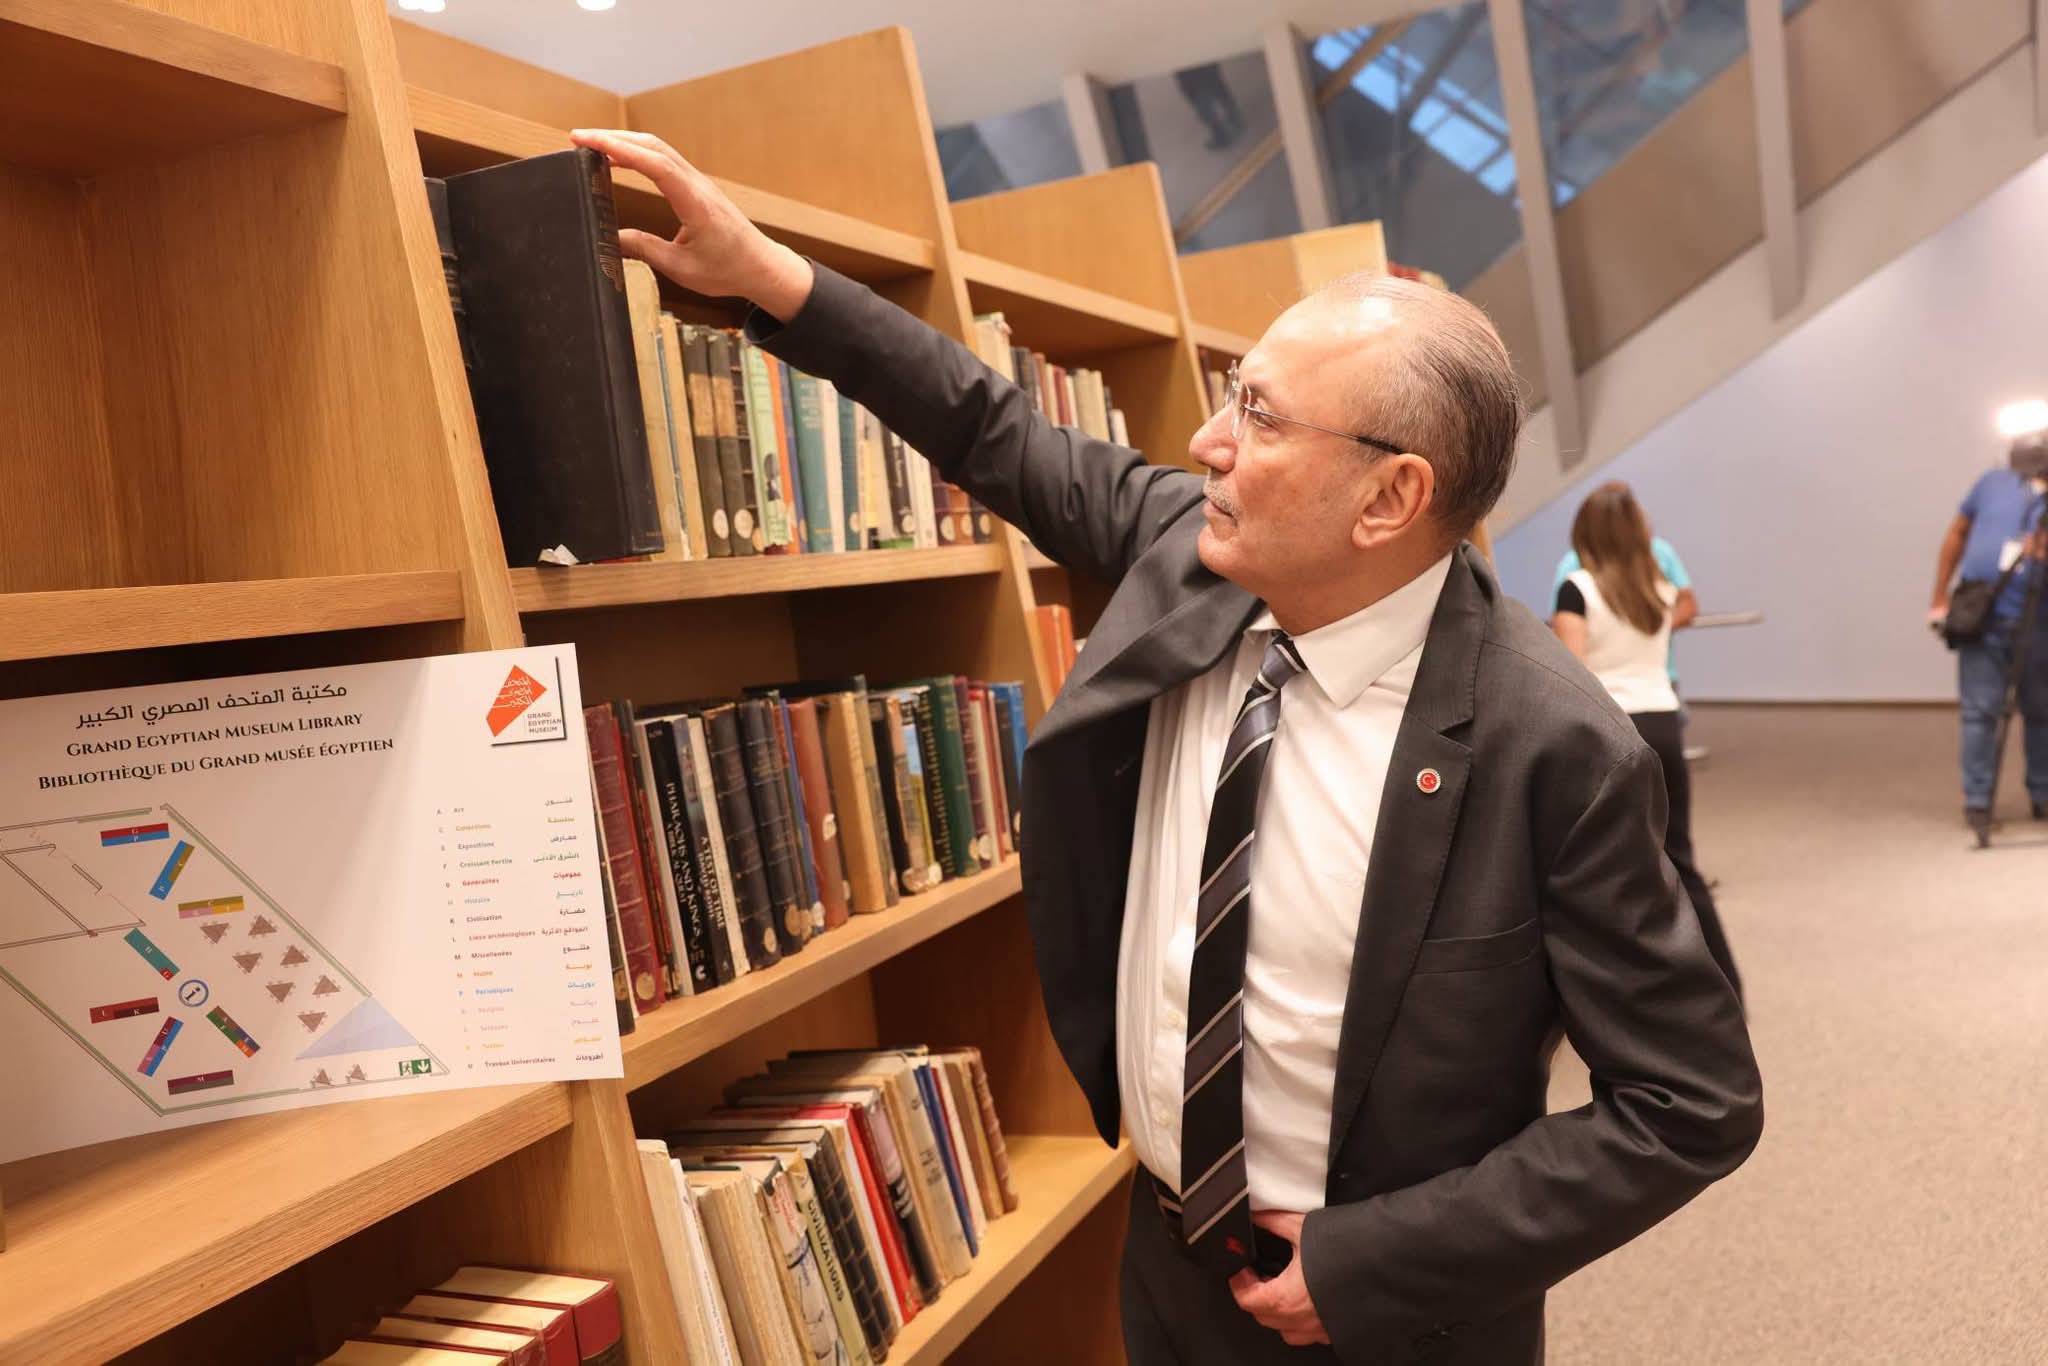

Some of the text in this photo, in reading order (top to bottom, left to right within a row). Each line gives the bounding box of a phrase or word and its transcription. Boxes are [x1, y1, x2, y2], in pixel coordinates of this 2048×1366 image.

[76, 684, 347, 730] مكتبة المتحف المصري الكبير
[528, 718, 562, 727] EGYPTIAN
[529, 726, 558, 734] MUSEUM
[171, 760, 195, 773] DU
[264, 744, 315, 762] MUSÉE
[319, 738, 393, 757] ÉGYPTIEN
[665, 782, 688, 857] PHARAOHS
[459, 860, 490, 868] Croissant
[680, 860, 694, 891] AND
[700, 835, 725, 929] A TEST OF TIME
[466, 914, 502, 922] Civilisation
[686, 893, 703, 937] KINGS
[511, 1057, 556, 1066] Universitaires
[807, 1199, 844, 1302] CIVILIZATIONS
